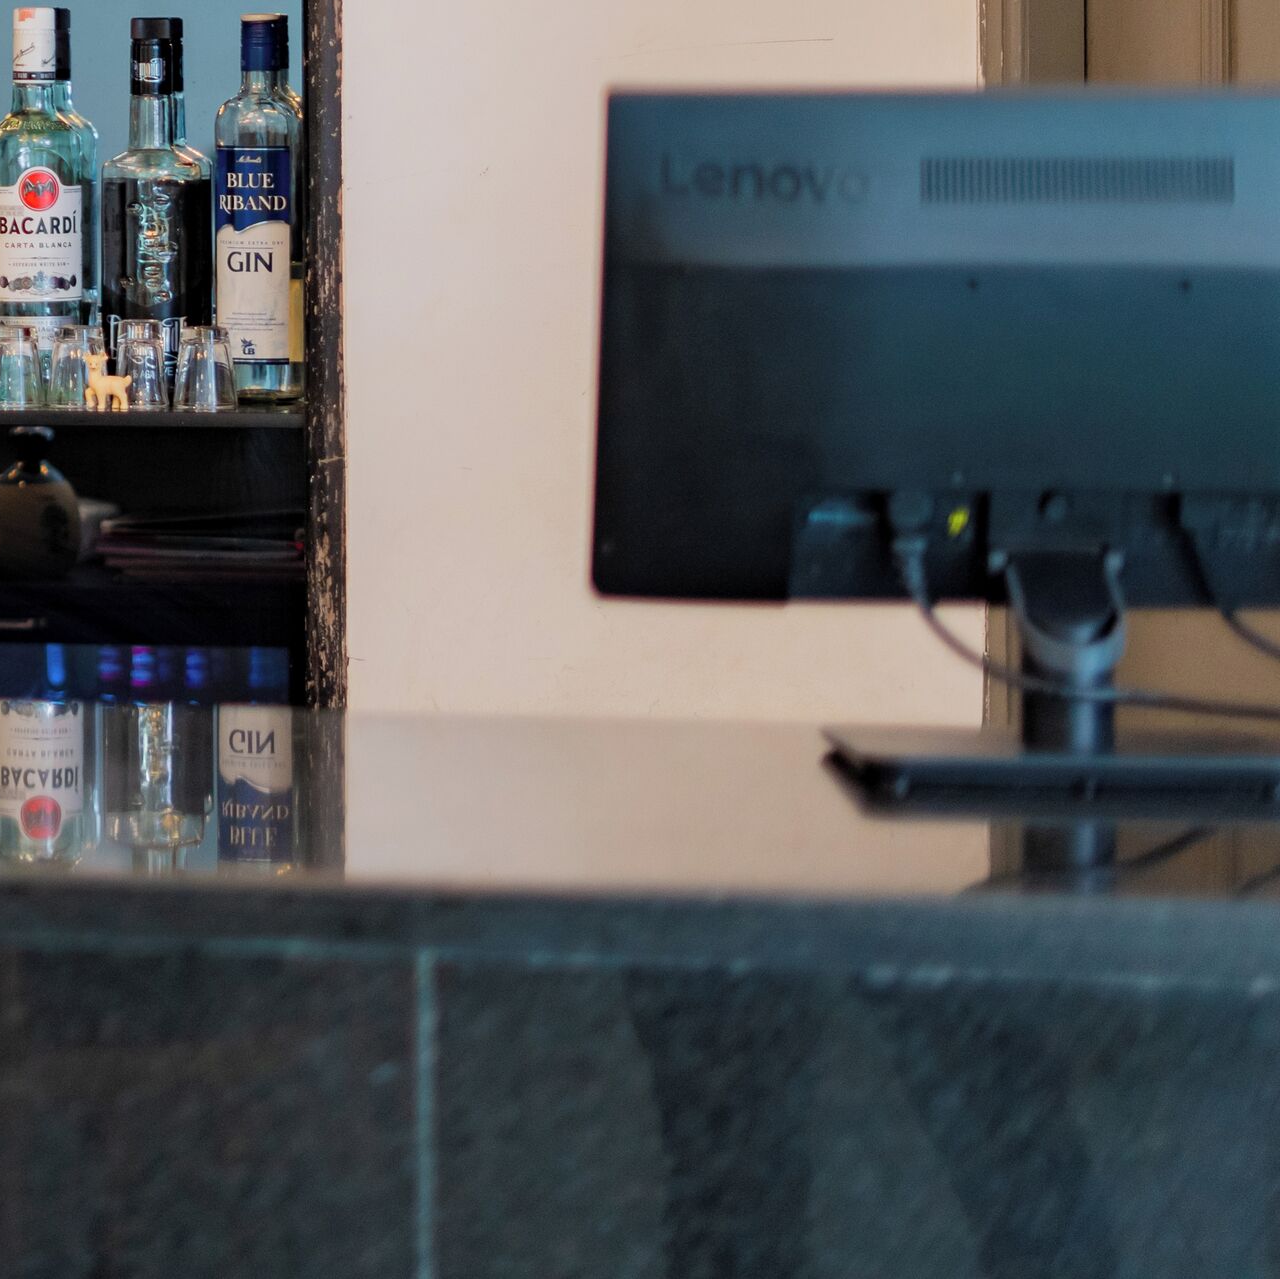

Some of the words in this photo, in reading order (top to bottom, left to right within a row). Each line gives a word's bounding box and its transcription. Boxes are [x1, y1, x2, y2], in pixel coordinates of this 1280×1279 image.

[226, 172, 275, 188] BLUE
[657, 152, 871, 206] Lenovo
[219, 194, 287, 214] RIBAND
[0, 210, 77, 235] BACARDÍ
[227, 251, 273, 273] GIN
